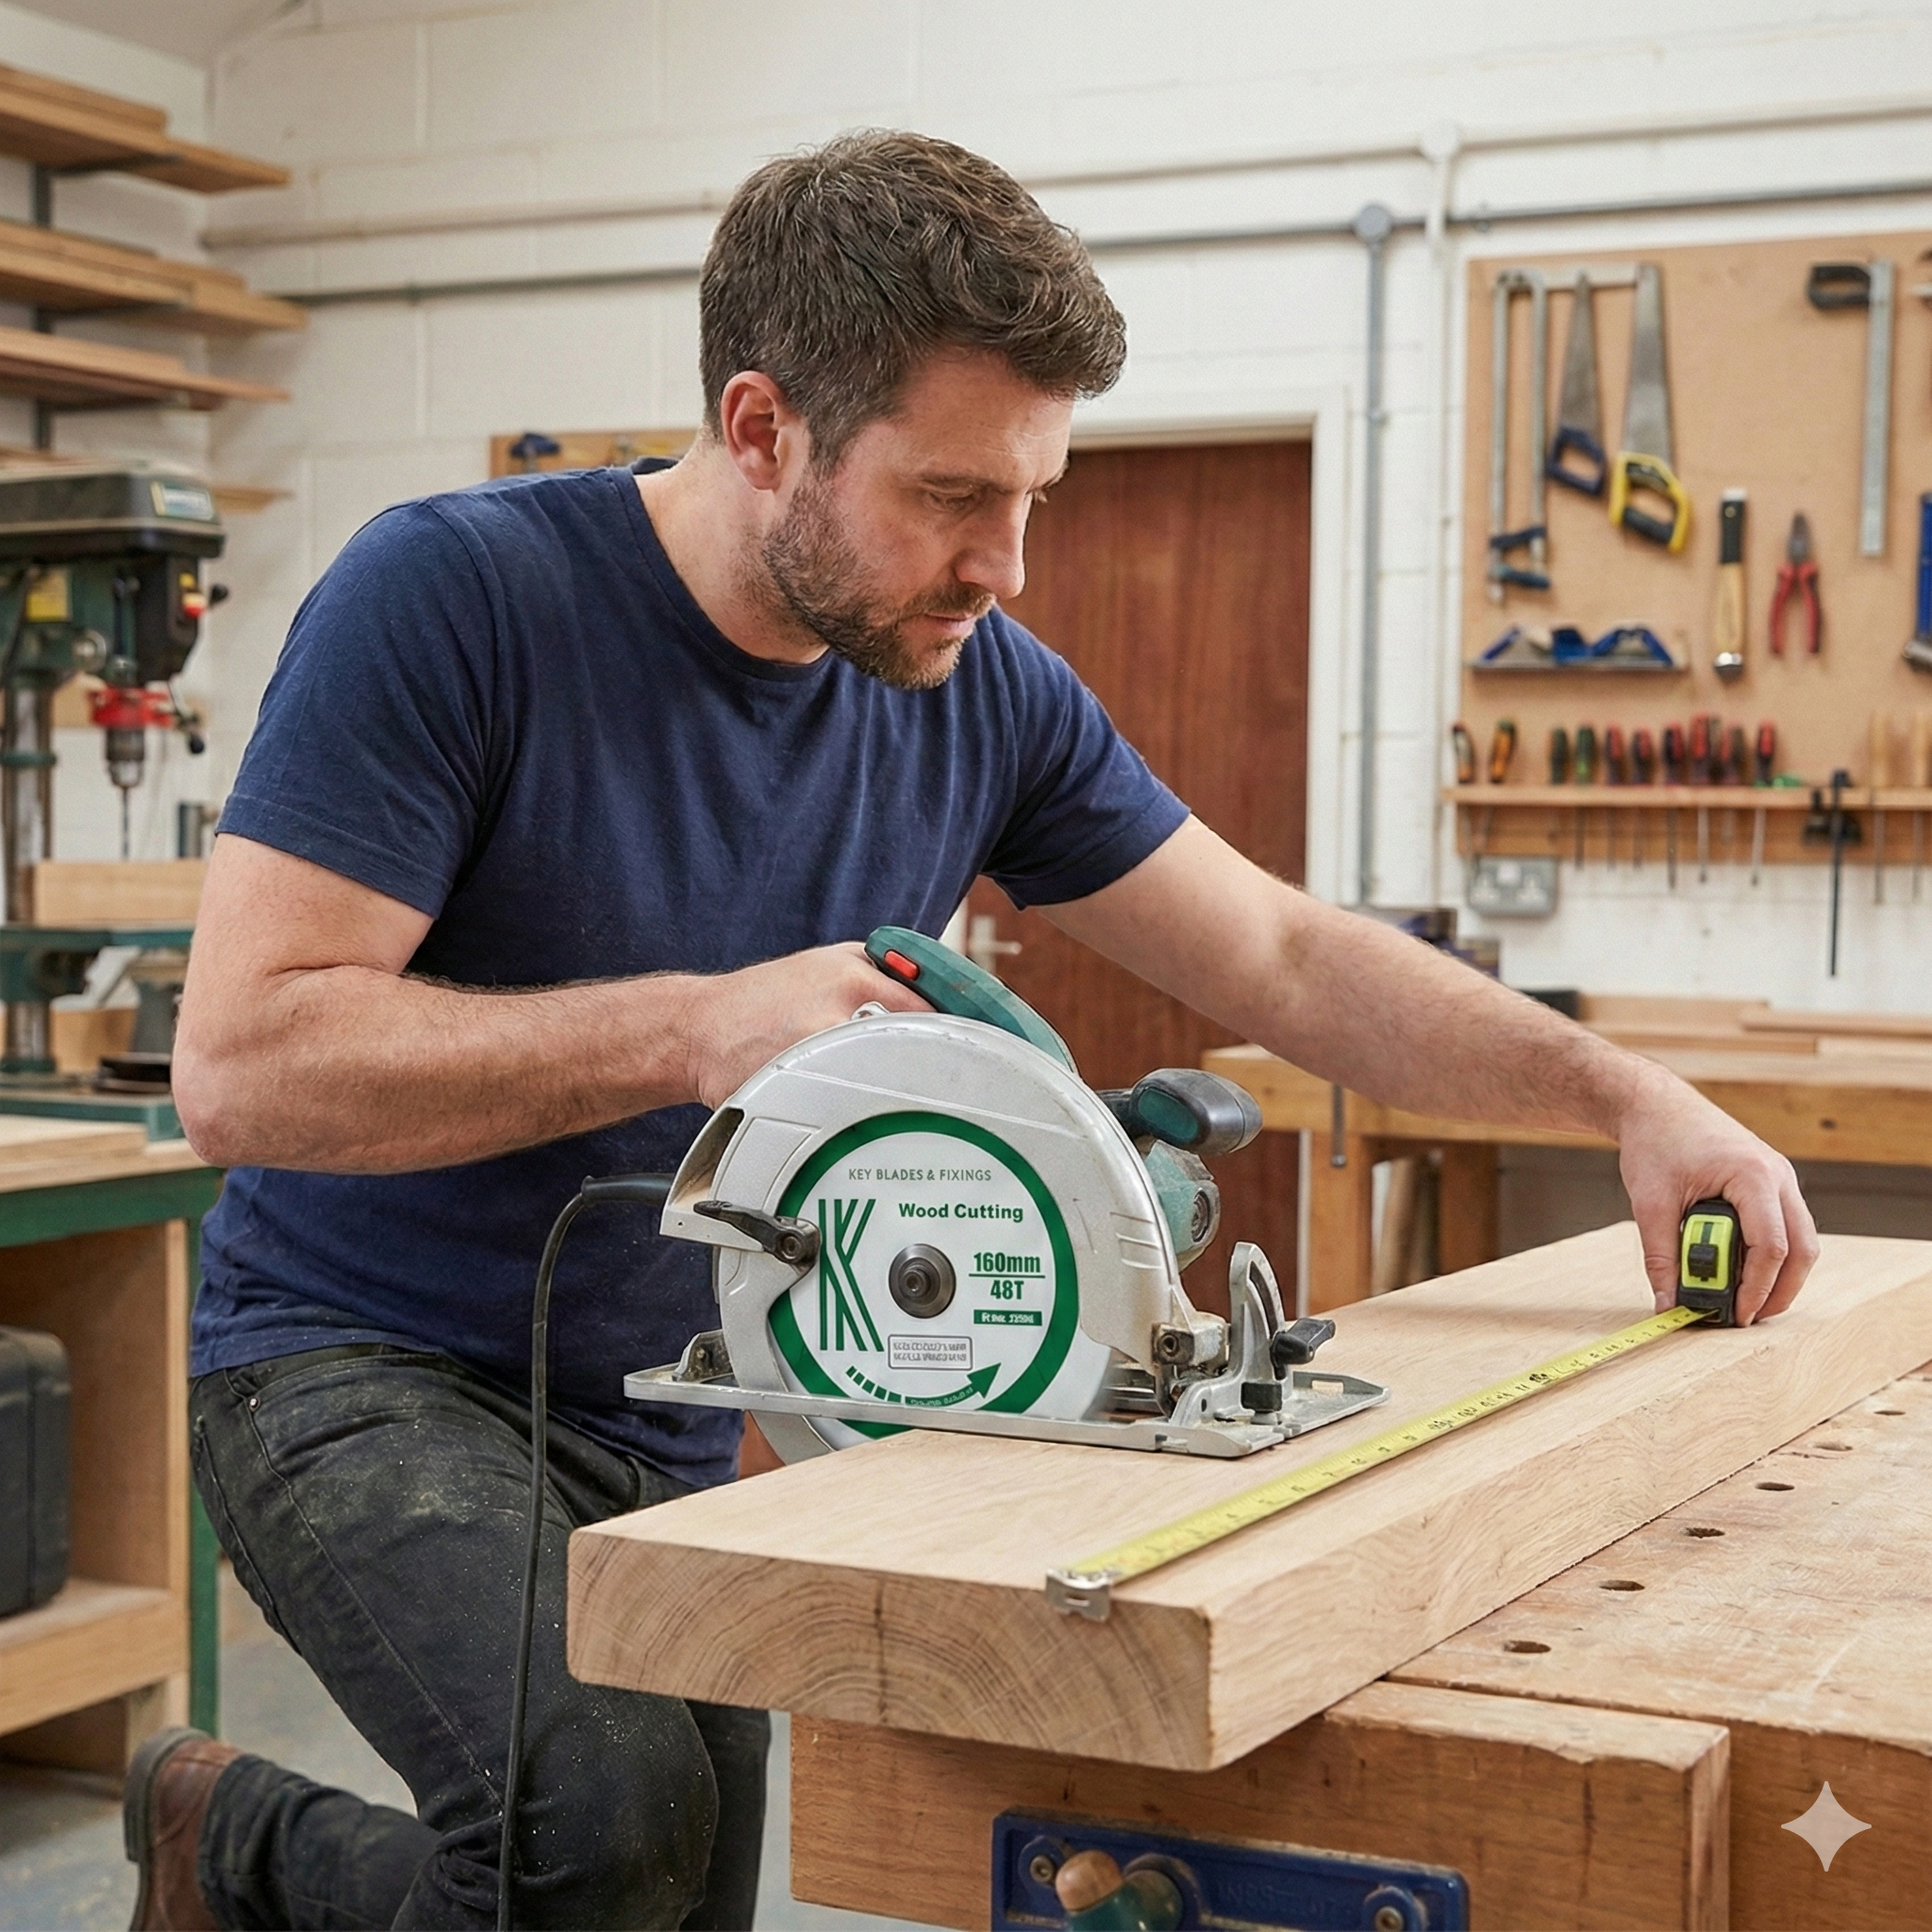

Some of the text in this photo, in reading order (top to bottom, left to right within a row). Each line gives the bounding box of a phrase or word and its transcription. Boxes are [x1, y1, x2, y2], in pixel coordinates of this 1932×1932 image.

[848, 1168, 992, 1182] KEY BLADES & FIXINGS
[898, 1203, 1024, 1224] Wood Cutting
[973, 1252, 1041, 1274] 160mm
[990, 1279, 1024, 1301] 48T
